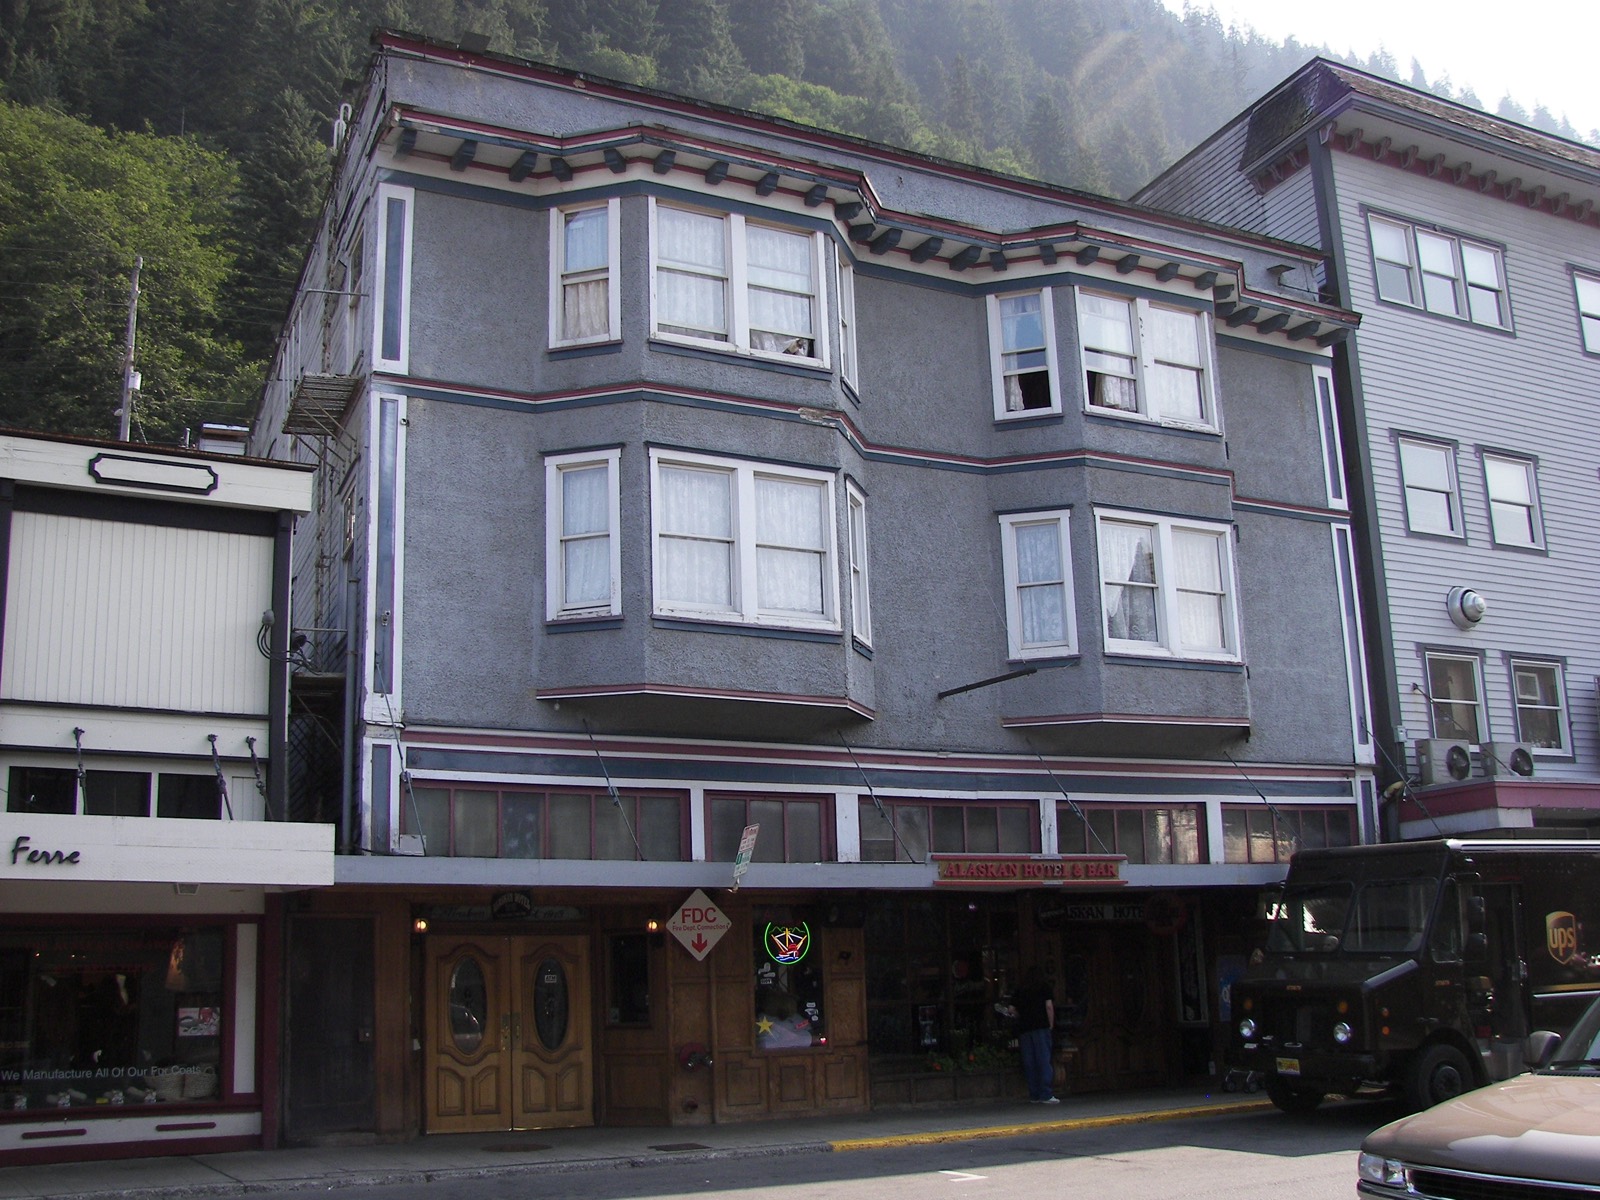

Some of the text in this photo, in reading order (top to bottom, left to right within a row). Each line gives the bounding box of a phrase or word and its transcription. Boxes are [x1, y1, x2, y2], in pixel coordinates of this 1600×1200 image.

[12, 836, 81, 865] Ferre
[944, 863, 1118, 878] ALASKAN HOTEL & BAR
[681, 907, 717, 923] FDC
[1113, 905, 1145, 920] HOTE
[1549, 927, 1575, 956] ups
[1, 1065, 201, 1081] We Manufacture All Of Our Fur Coats
